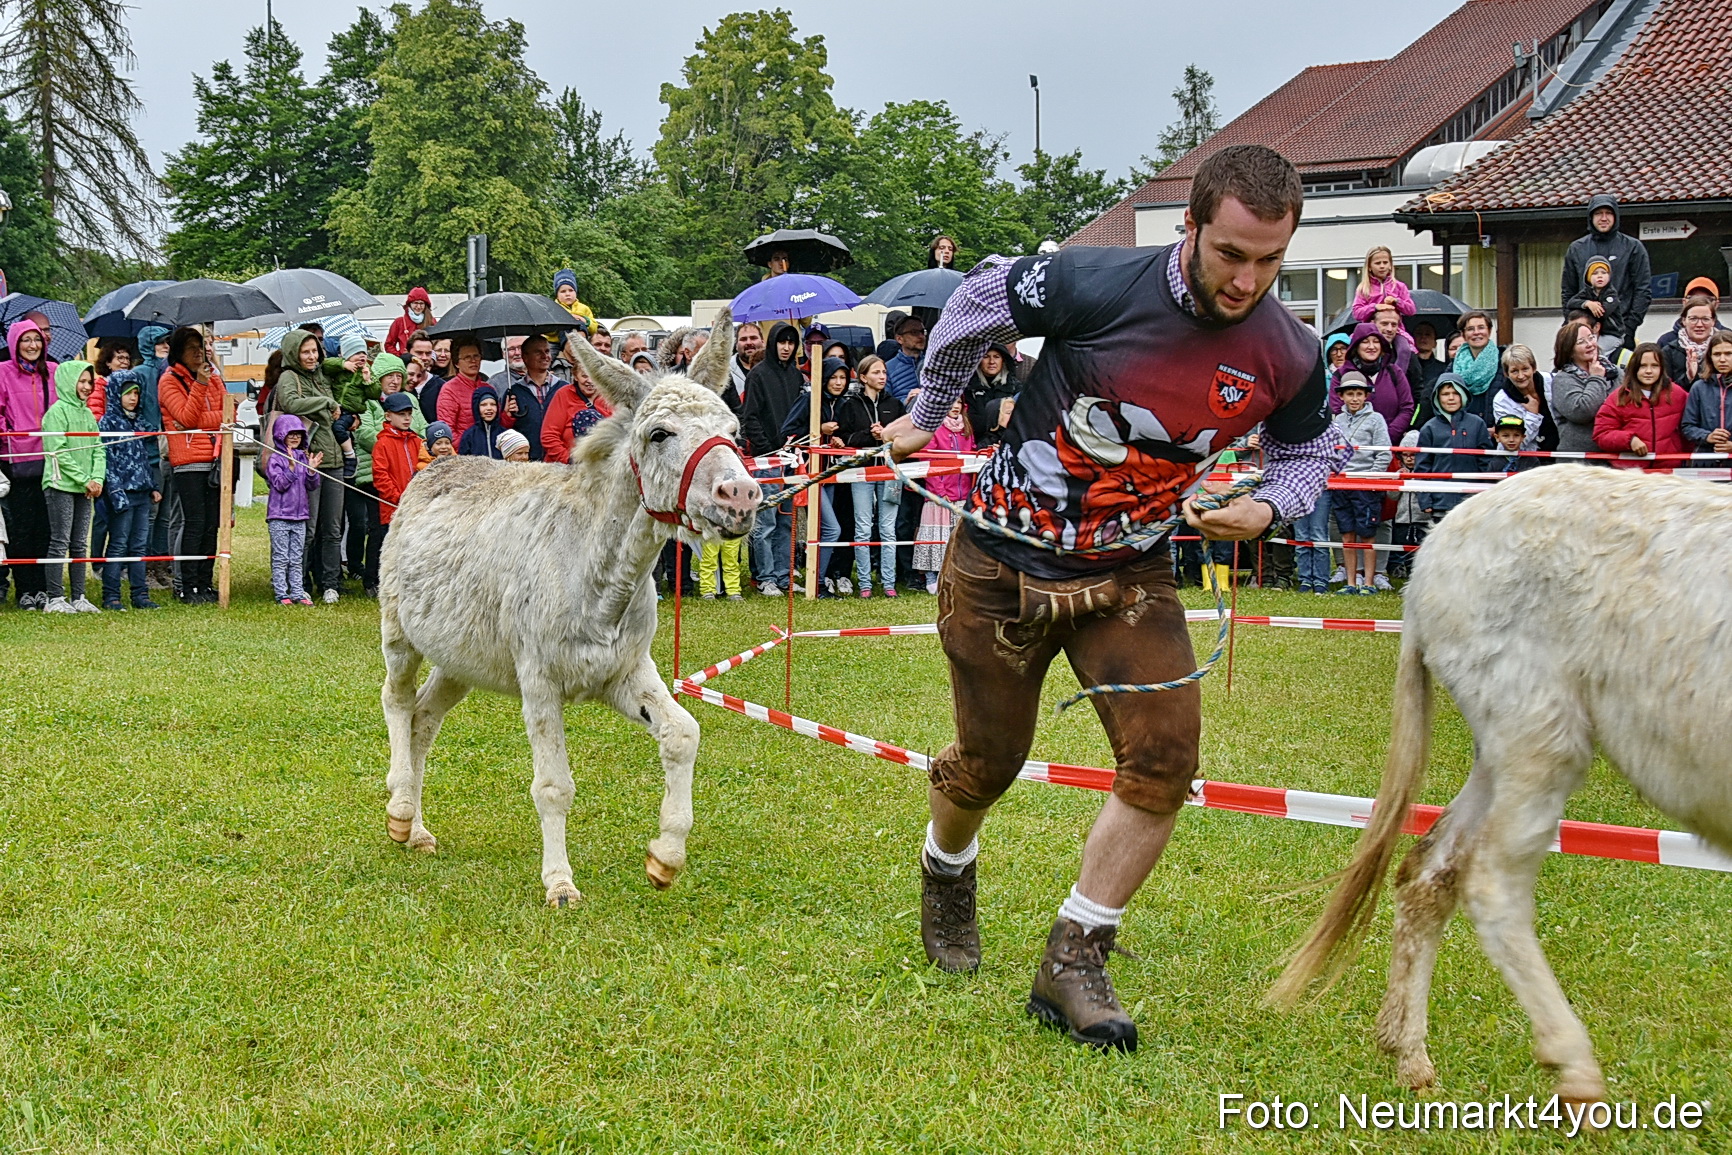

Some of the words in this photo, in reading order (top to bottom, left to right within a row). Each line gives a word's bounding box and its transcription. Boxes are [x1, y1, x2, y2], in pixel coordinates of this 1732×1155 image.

[1642, 226, 1661, 235] Erste
[1662, 226, 1678, 234] Hilfe
[790, 291, 818, 304] Milka
[1219, 385, 1244, 403] ASV
